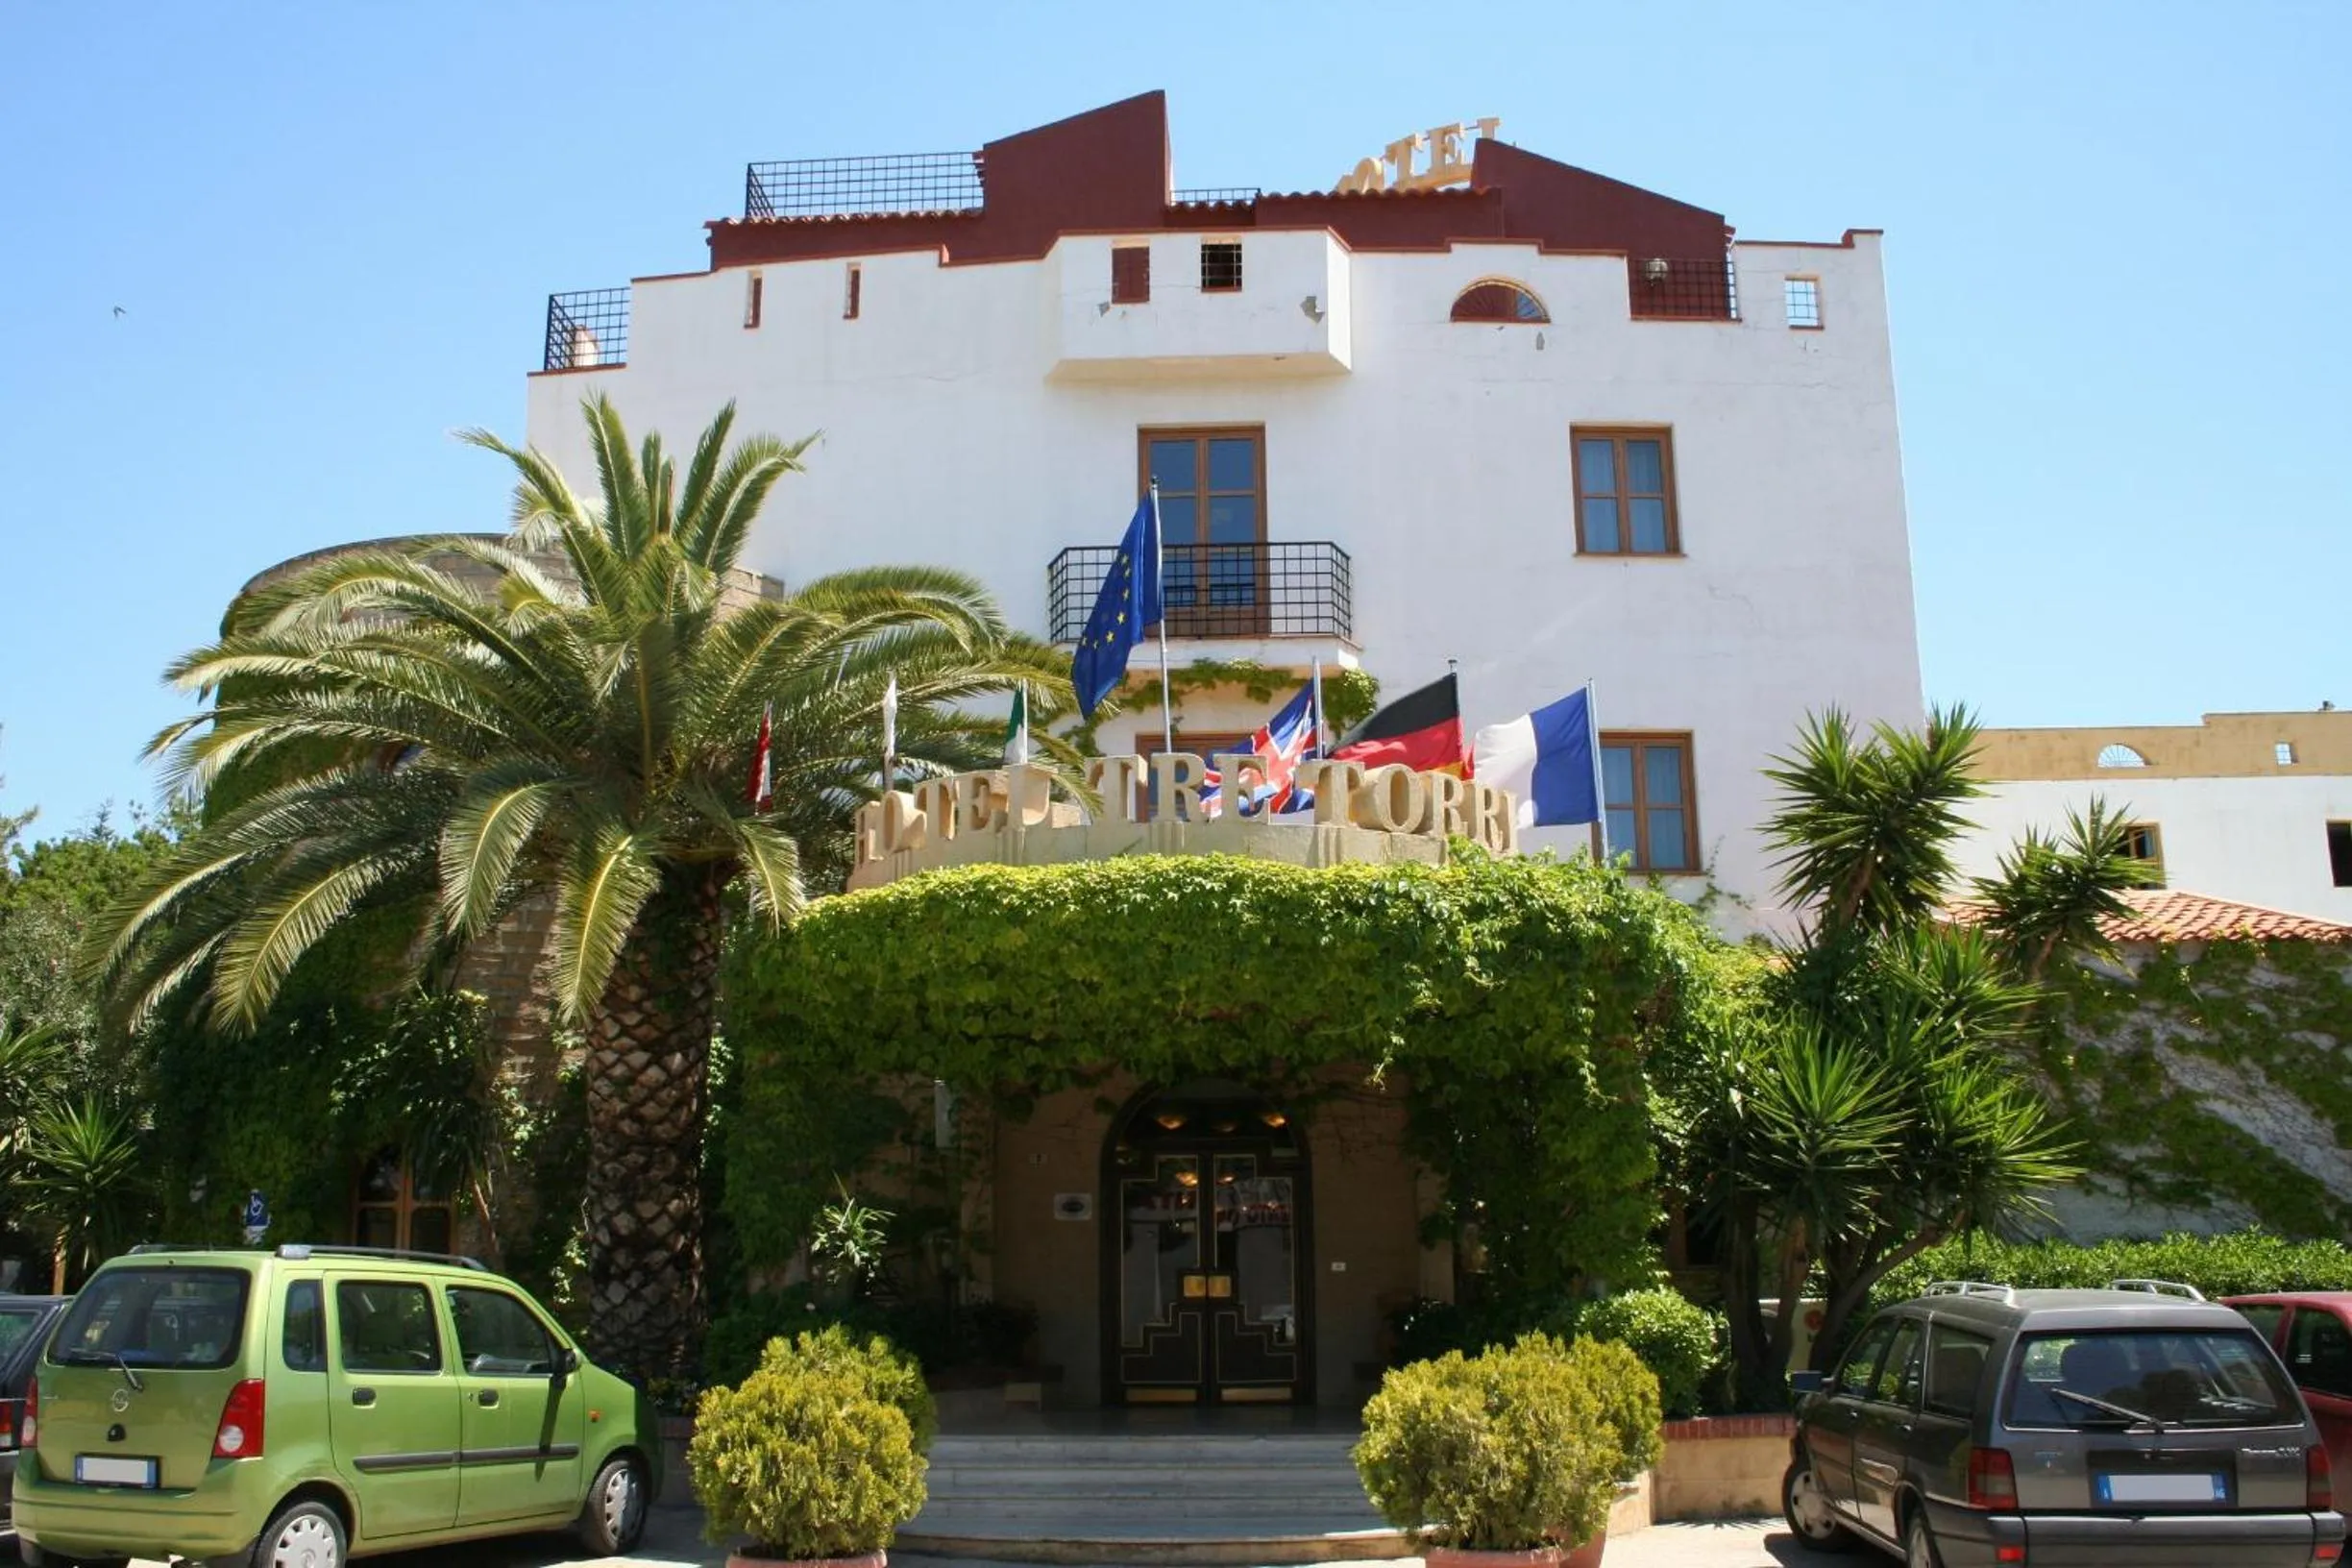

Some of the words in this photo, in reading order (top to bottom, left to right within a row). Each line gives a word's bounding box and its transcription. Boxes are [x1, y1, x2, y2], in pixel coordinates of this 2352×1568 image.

[855, 764, 1068, 864] HOTEL
[1085, 752, 1270, 824] TRE
[1295, 758, 1520, 853] TORRI
